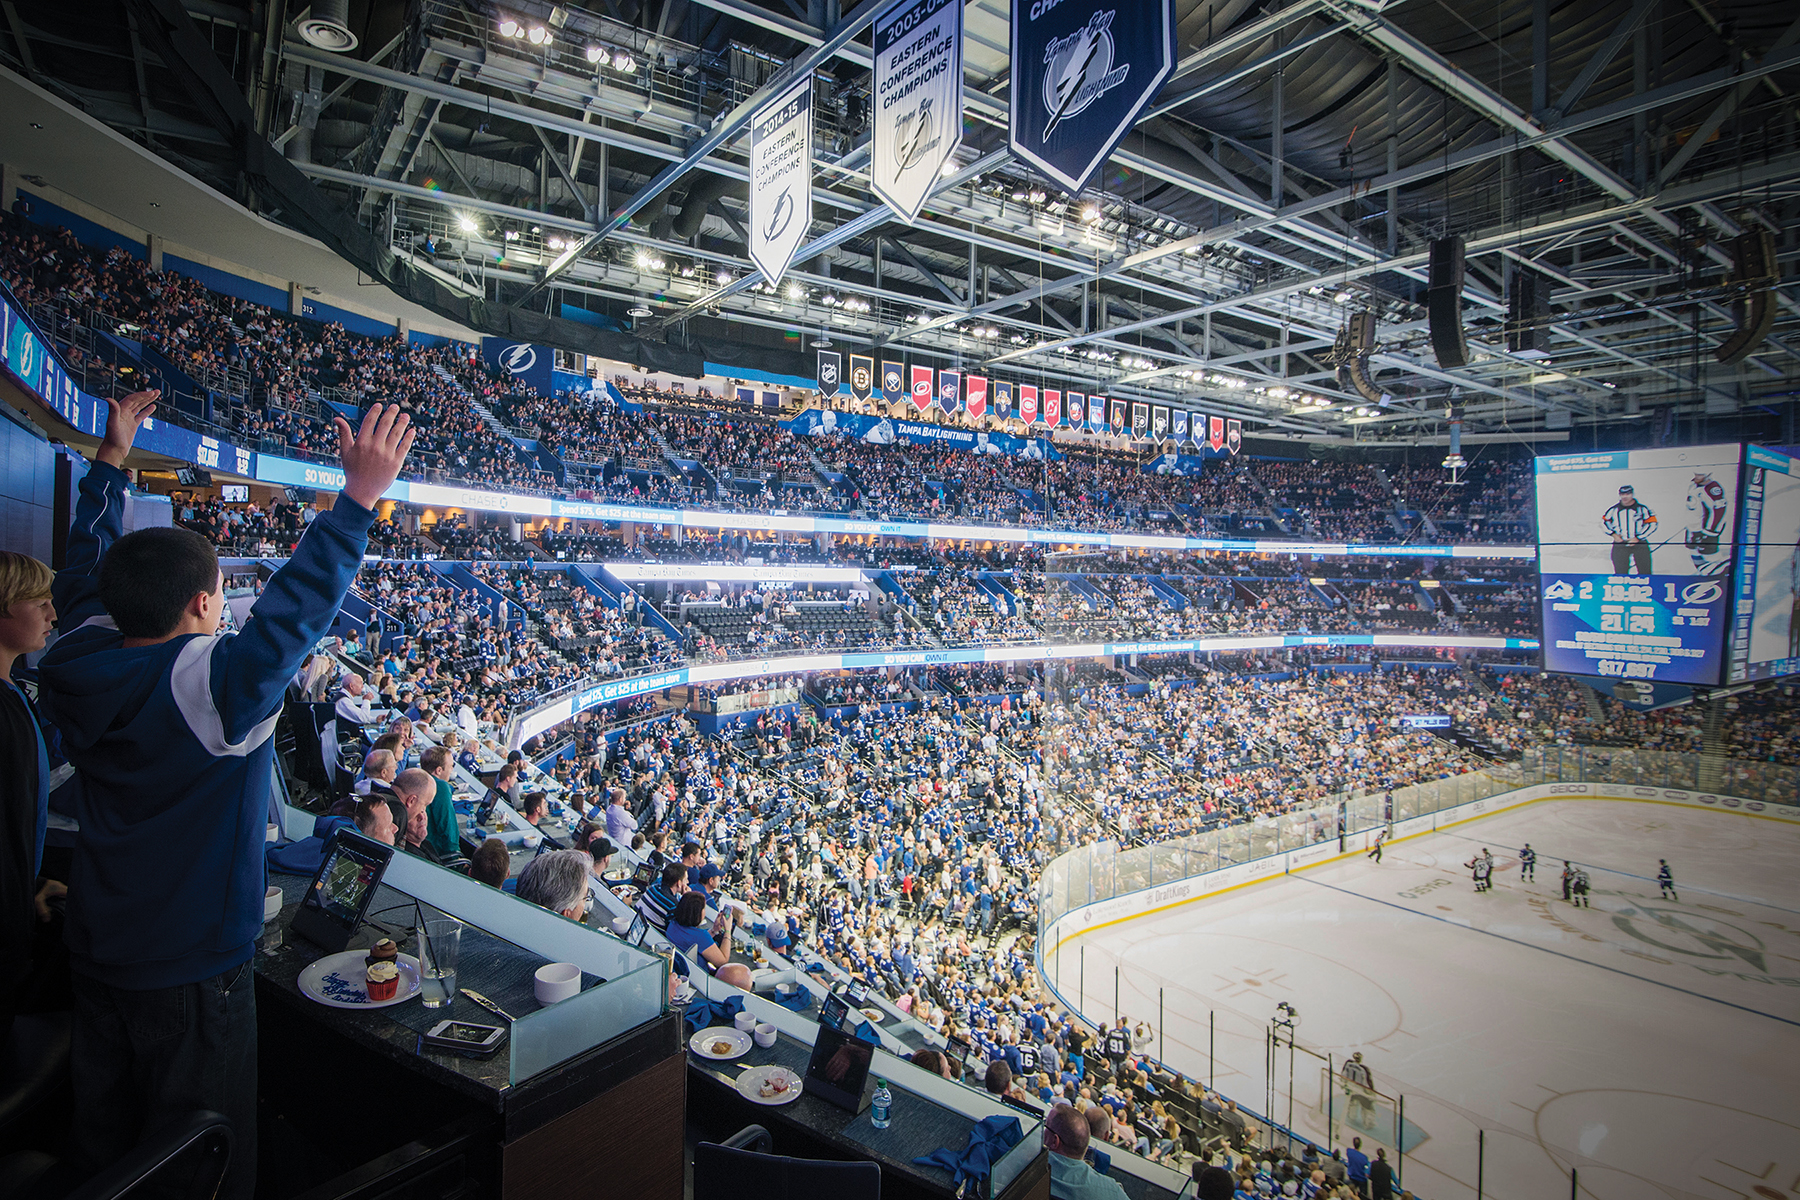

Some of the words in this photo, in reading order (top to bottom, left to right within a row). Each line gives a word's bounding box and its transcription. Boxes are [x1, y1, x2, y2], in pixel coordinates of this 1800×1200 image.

[891, 24, 940, 70] EASTERN
[880, 35, 953, 94] CONFERENCE
[883, 58, 947, 109] CHAMPIONS
[762, 100, 798, 137] 2014-15
[763, 129, 796, 159] EASTERN
[755, 138, 804, 178] CONFERENCE
[758, 157, 800, 191] CHAMPIONS
[303, 304, 314, 314] 312
[305, 468, 317, 483] SO
[318, 471, 335, 486] YOU
[461, 493, 497, 507] CHASE
[559, 504, 578, 515] Spend
[596, 507, 608, 516] Get
[609, 508, 621, 517] $25
[622, 510, 630, 518] at
[630, 510, 641, 519] the
[660, 512, 675, 521] store
[854, 523, 866, 531] YOU
[1579, 581, 1593, 599] 2
[1664, 582, 1677, 602] 1
[1601, 614, 1623, 632] 21
[1630, 615, 1655, 633] 24
[884, 655, 895, 664] SO
[895, 654, 909, 663] YOU
[910, 654, 925, 662] CAN
[605, 686, 617, 698] Get
[618, 683, 630, 695] $25
[631, 682, 638, 692] at
[638, 680, 649, 690] the
[650, 677, 665, 688] team
[666, 673, 680, 684] store
[1550, 785, 1587, 794] GEICO
[1249, 860, 1275, 873] JABIL
[1155, 885, 1190, 903] DraftKings
[1109, 1038, 1125, 1054] 91
[1020, 1053, 1034, 1067] 16
